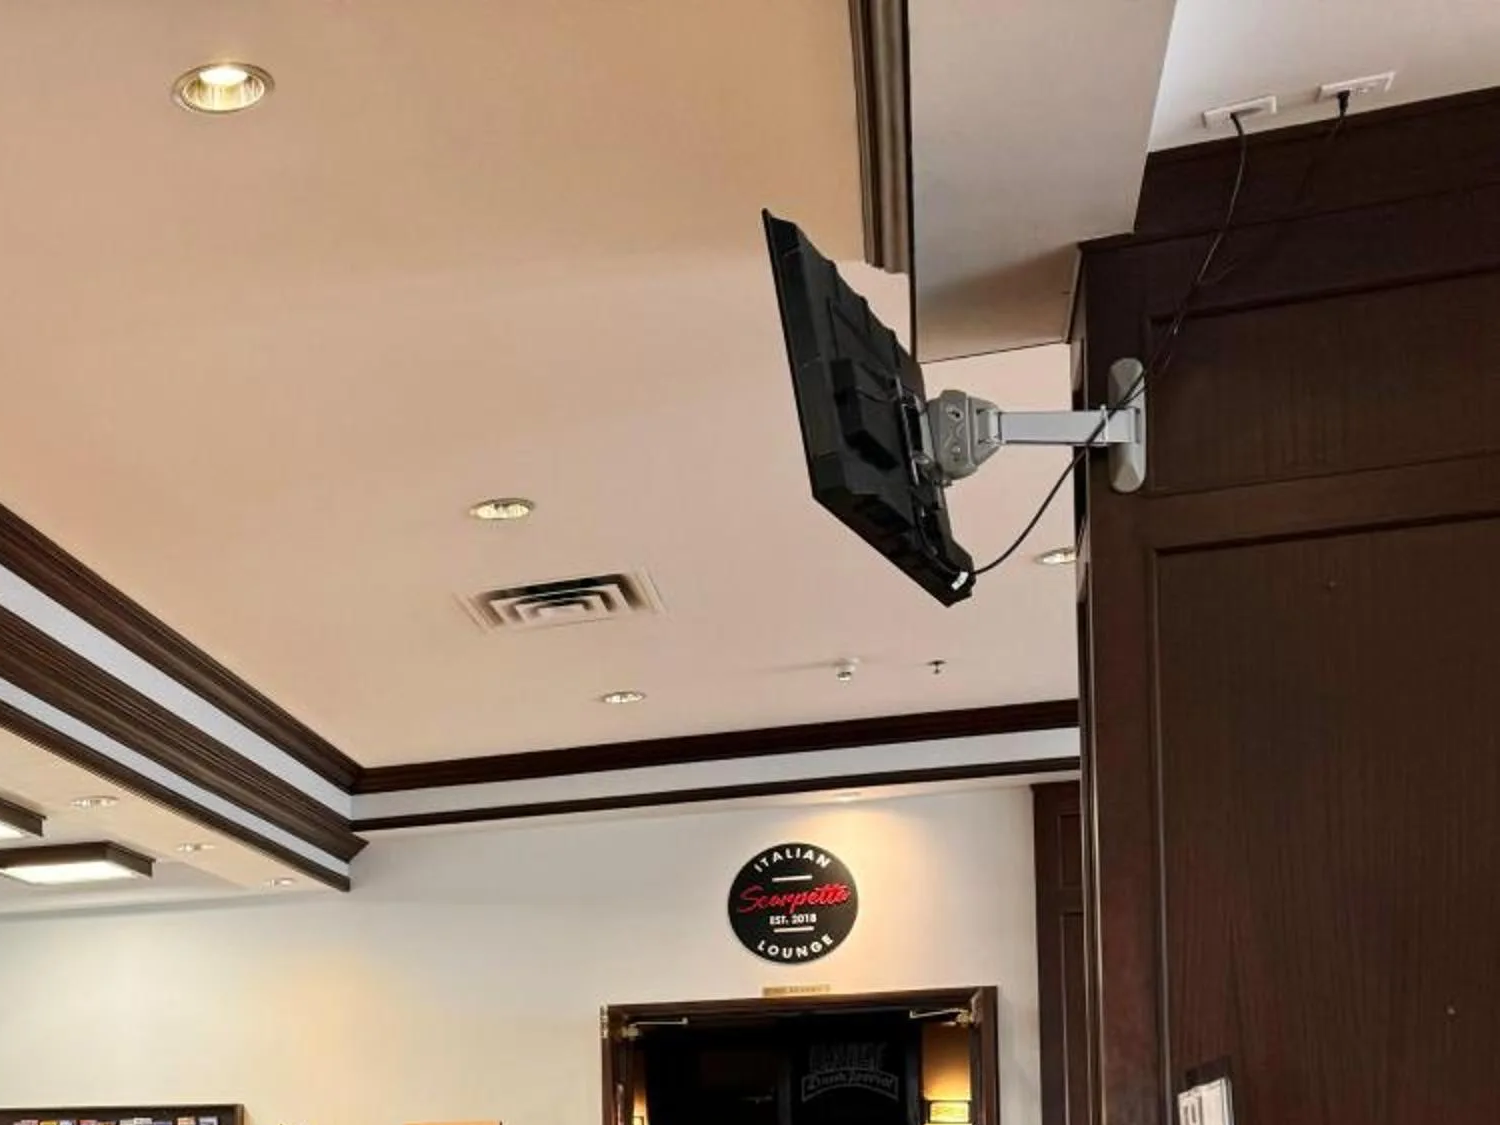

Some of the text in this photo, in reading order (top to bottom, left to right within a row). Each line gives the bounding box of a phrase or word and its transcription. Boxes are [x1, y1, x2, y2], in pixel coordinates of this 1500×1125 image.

[754, 848, 831, 873] ITALIAN
[769, 913, 817, 926] EST. 2018
[757, 933, 834, 959] LOUNGE
